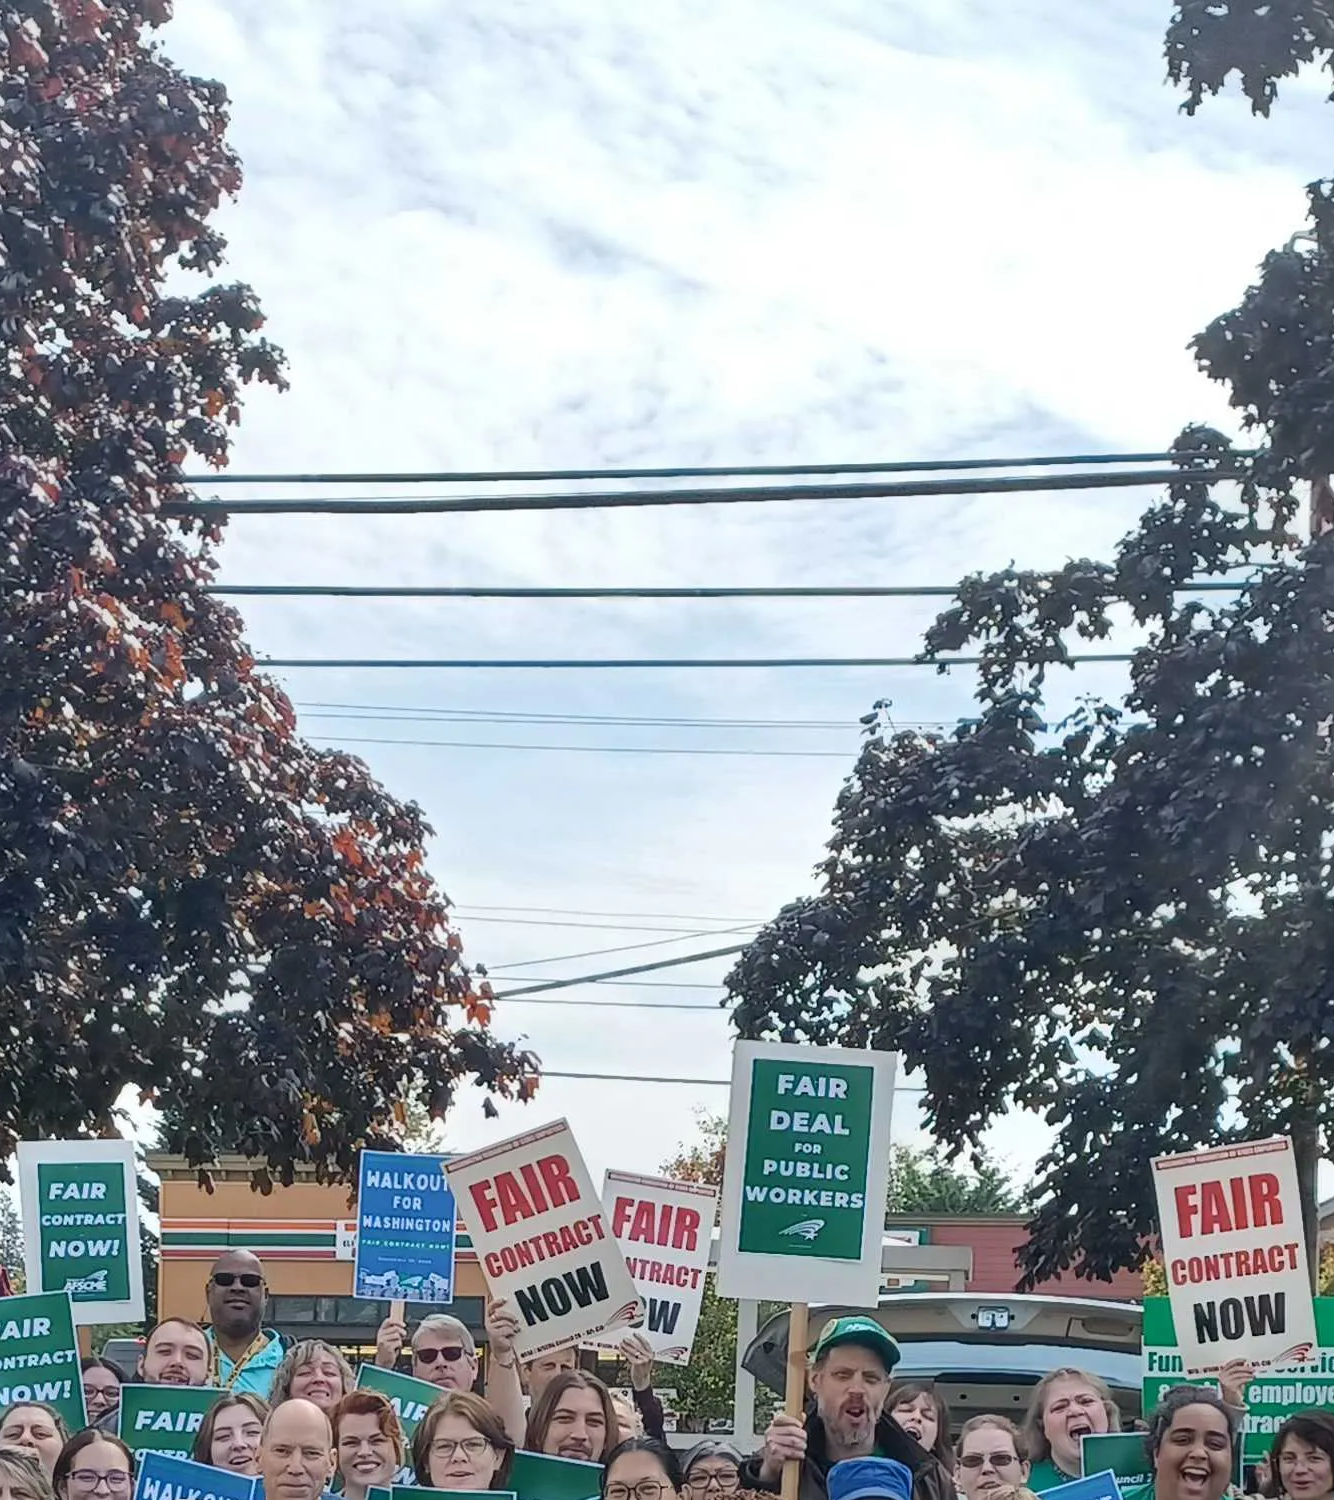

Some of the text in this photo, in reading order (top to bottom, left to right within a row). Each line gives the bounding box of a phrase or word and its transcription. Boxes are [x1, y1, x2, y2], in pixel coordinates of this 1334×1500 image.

[777, 1073, 849, 1100] FAIR
[769, 1110, 851, 1136] DEAL
[794, 1143, 822, 1155] FOR
[367, 1170, 449, 1192] WALKOUT
[763, 1159, 851, 1182] PUBLIC
[49, 1183, 107, 1200] FAIR
[393, 1196, 422, 1210] FOR
[468, 1154, 581, 1233] FAIR
[745, 1184, 865, 1210] WORKERS
[1174, 1172, 1284, 1239] FAIR
[41, 1213, 127, 1227] CONTRACT
[362, 1215, 451, 1232] WASHINGTON
[612, 1196, 701, 1252] FAIR
[49, 1239, 120, 1258] NOW!
[384, 1240, 425, 1248] CONTRACT
[483, 1215, 607, 1279] CONTRACT
[625, 1256, 703, 1290] NTRACT
[1170, 1243, 1299, 1287] CONTRACT
[515, 1261, 611, 1328] NOW
[1193, 1292, 1287, 1344] NOW
[135, 1410, 205, 1432] FAIR
